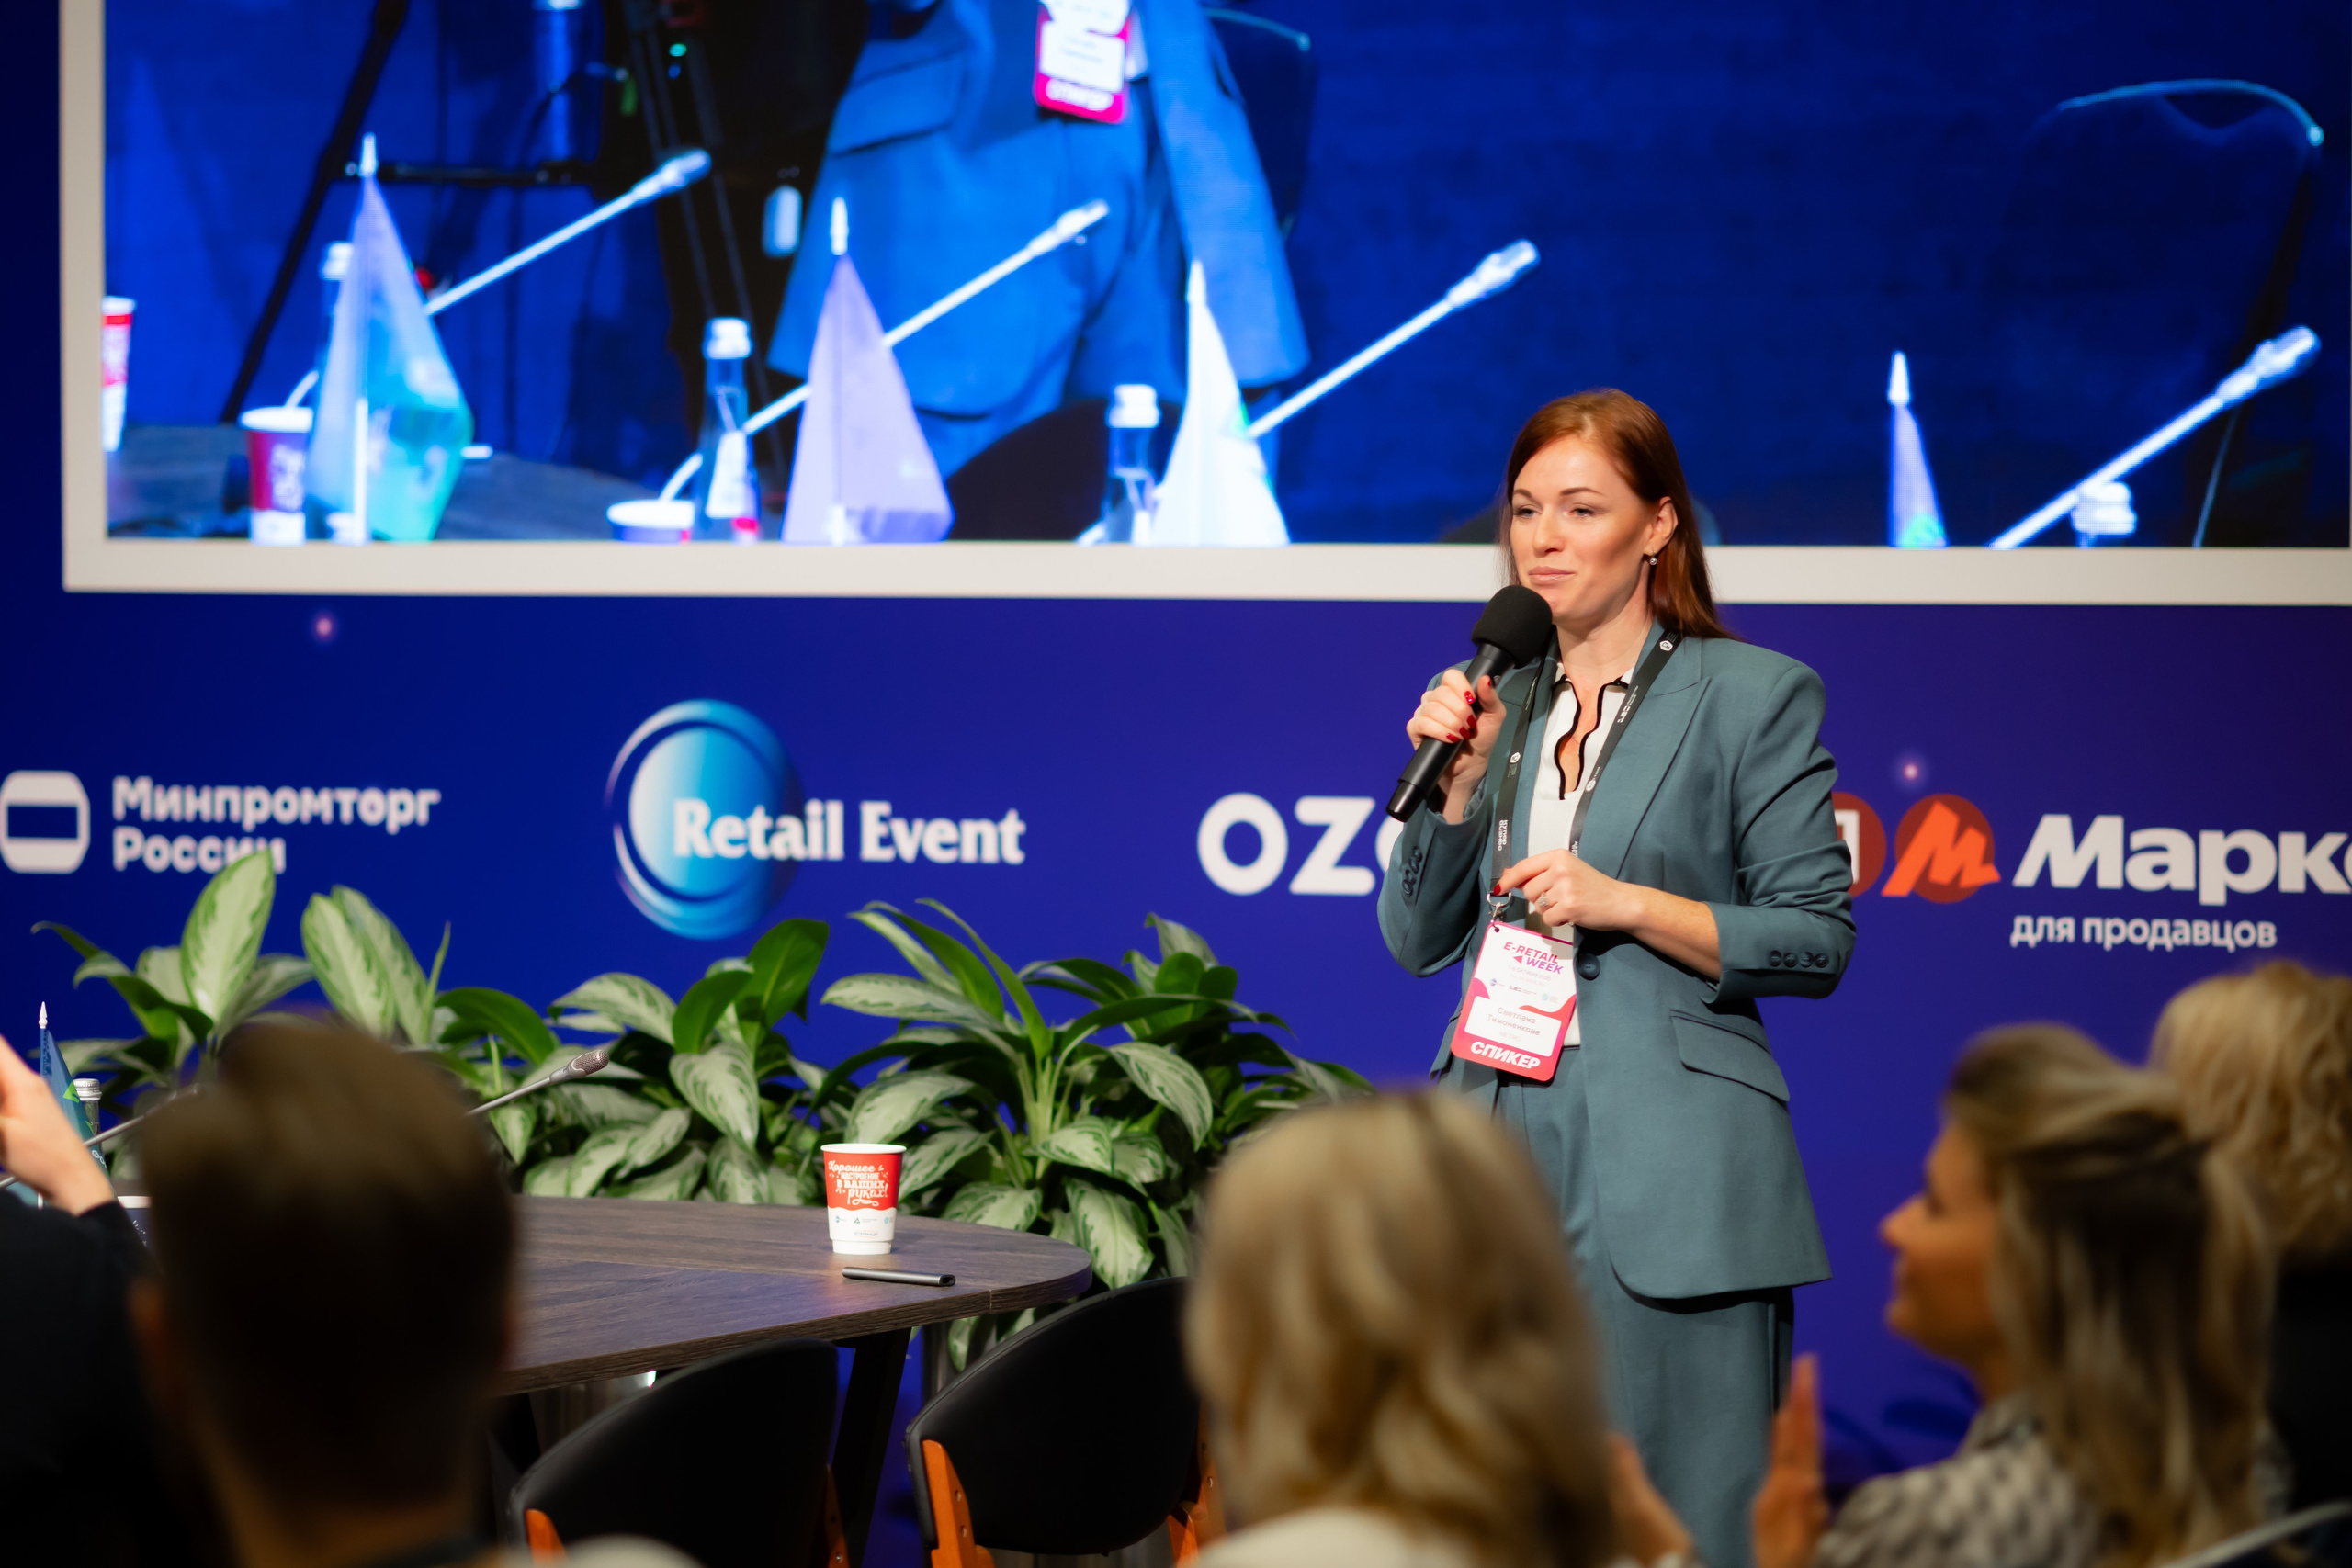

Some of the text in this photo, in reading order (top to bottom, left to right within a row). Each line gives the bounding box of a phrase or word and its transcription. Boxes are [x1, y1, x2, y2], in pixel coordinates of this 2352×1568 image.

[112, 776, 441, 834] Минпромторг
[672, 798, 1027, 865] Retail Event
[1196, 791, 1404, 897] OZ
[2012, 814, 2352, 906] Марк
[2009, 915, 2278, 953] для продавцов
[1503, 942, 1558, 964] E-RETAIL
[1526, 957, 1564, 975] WEEK
[1487, 1014, 1541, 1036] Тимоненкова
[1497, 1007, 1536, 1024] Светлана
[1470, 1040, 1541, 1069] СПИКЕР
[840, 1172, 880, 1180] НАСТРОЕНИЕ
